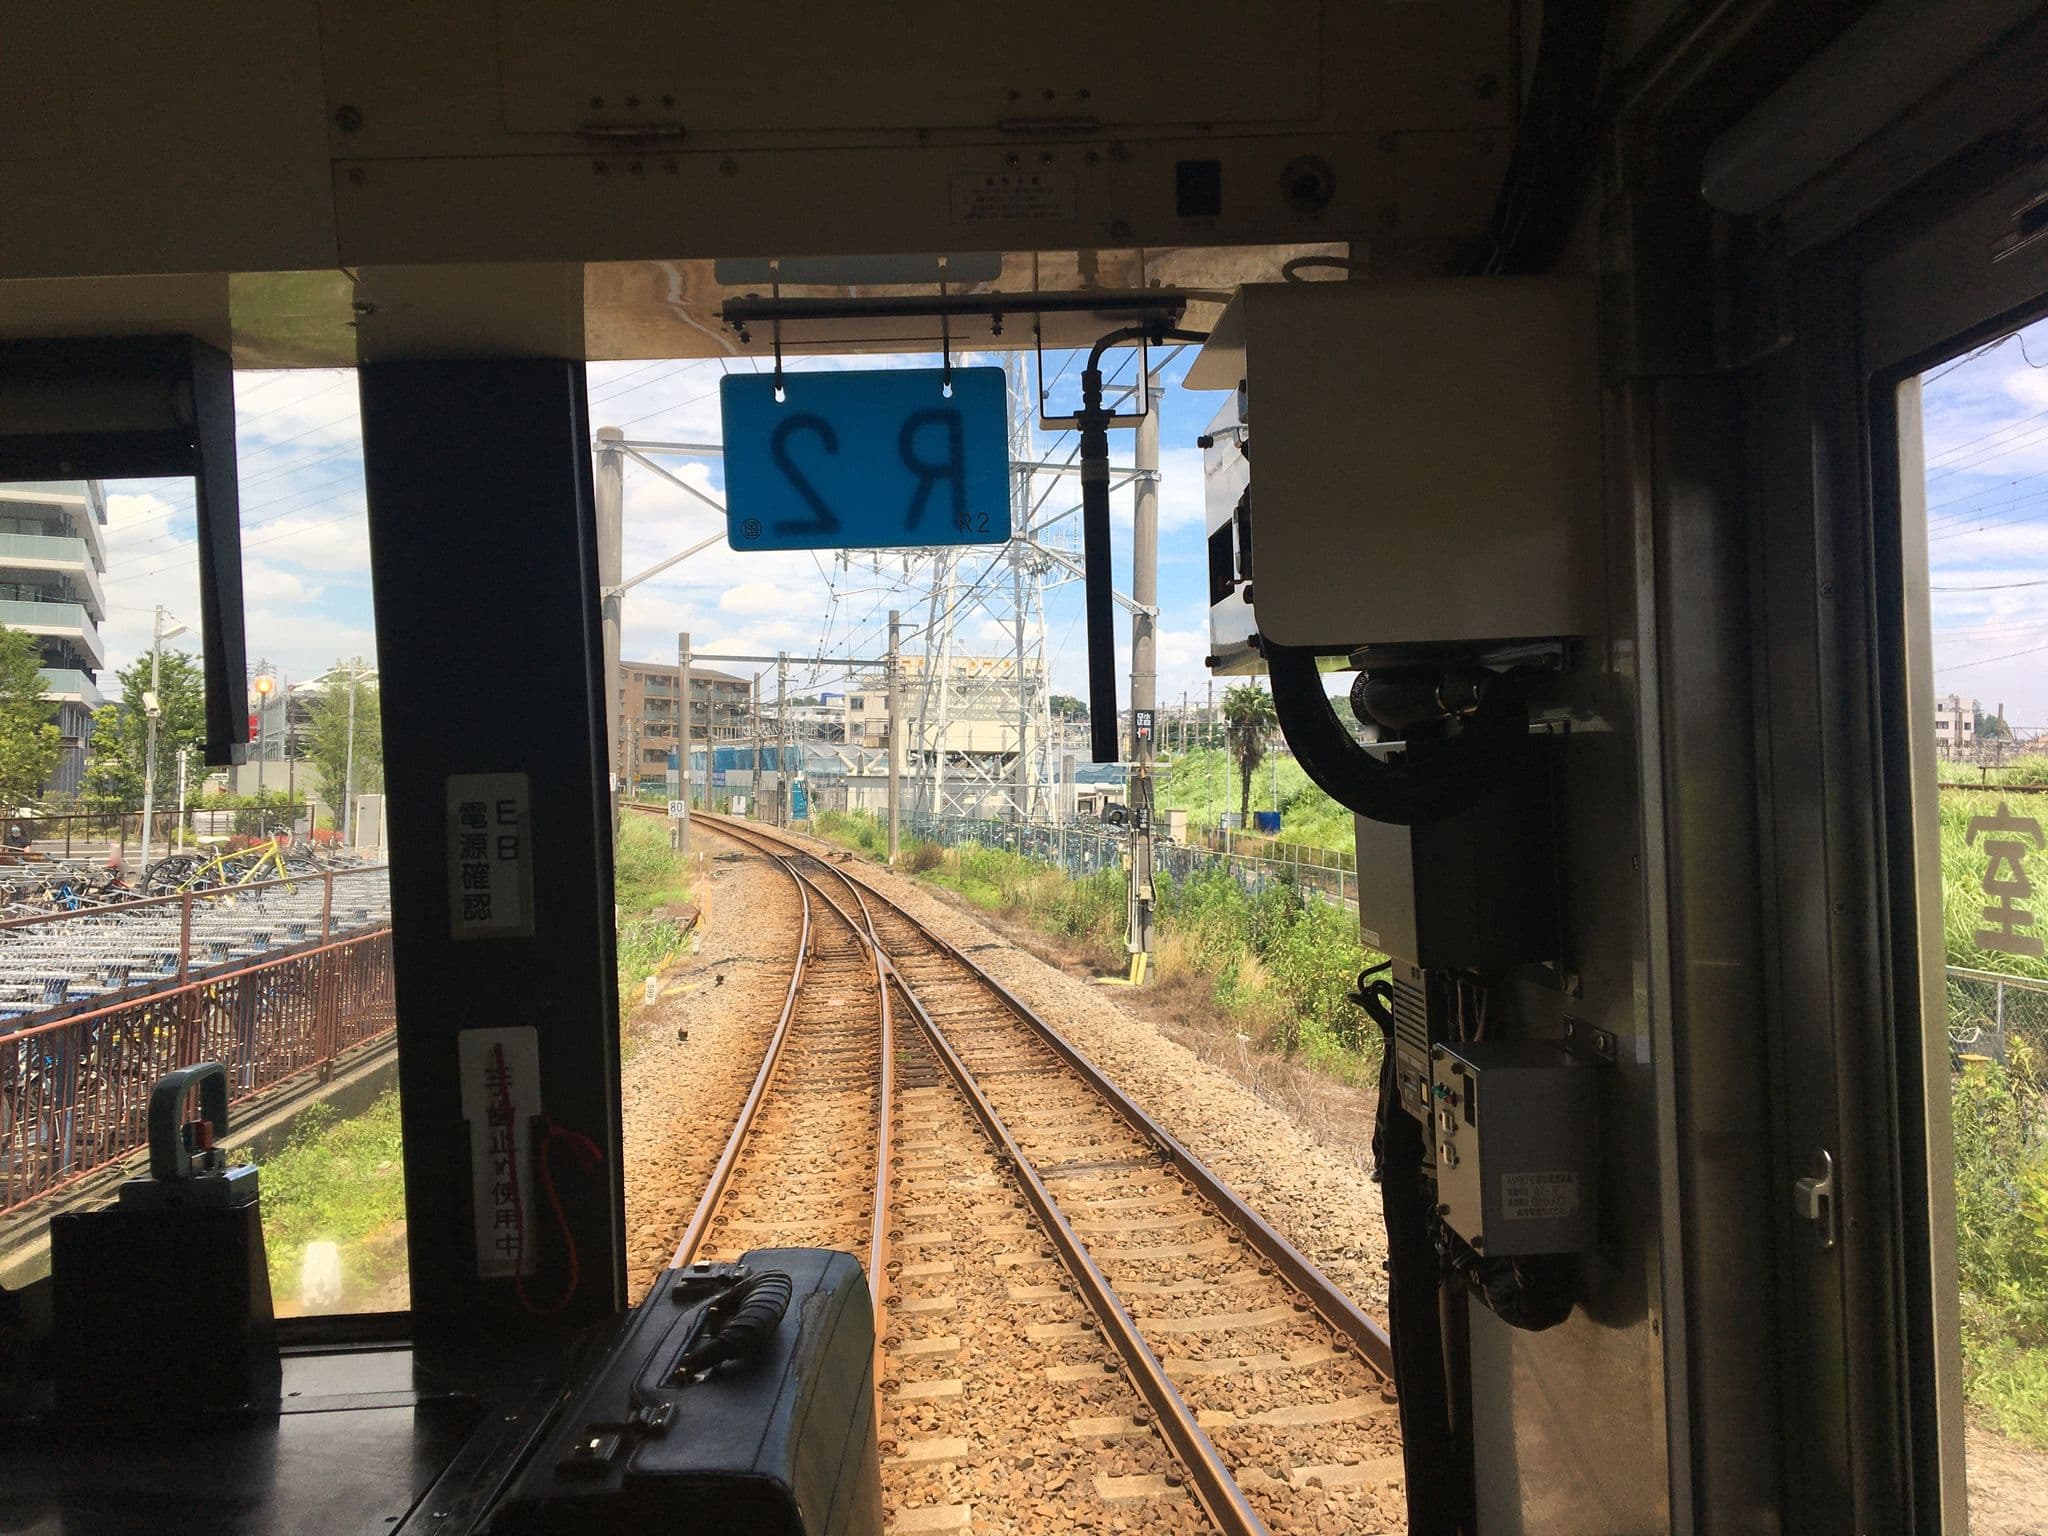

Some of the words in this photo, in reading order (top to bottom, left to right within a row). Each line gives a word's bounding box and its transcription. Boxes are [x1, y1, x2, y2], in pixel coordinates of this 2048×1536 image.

[958, 511, 990, 534] R2
[670, 801, 683, 813] 80
[458, 801, 492, 921] 電源確認
